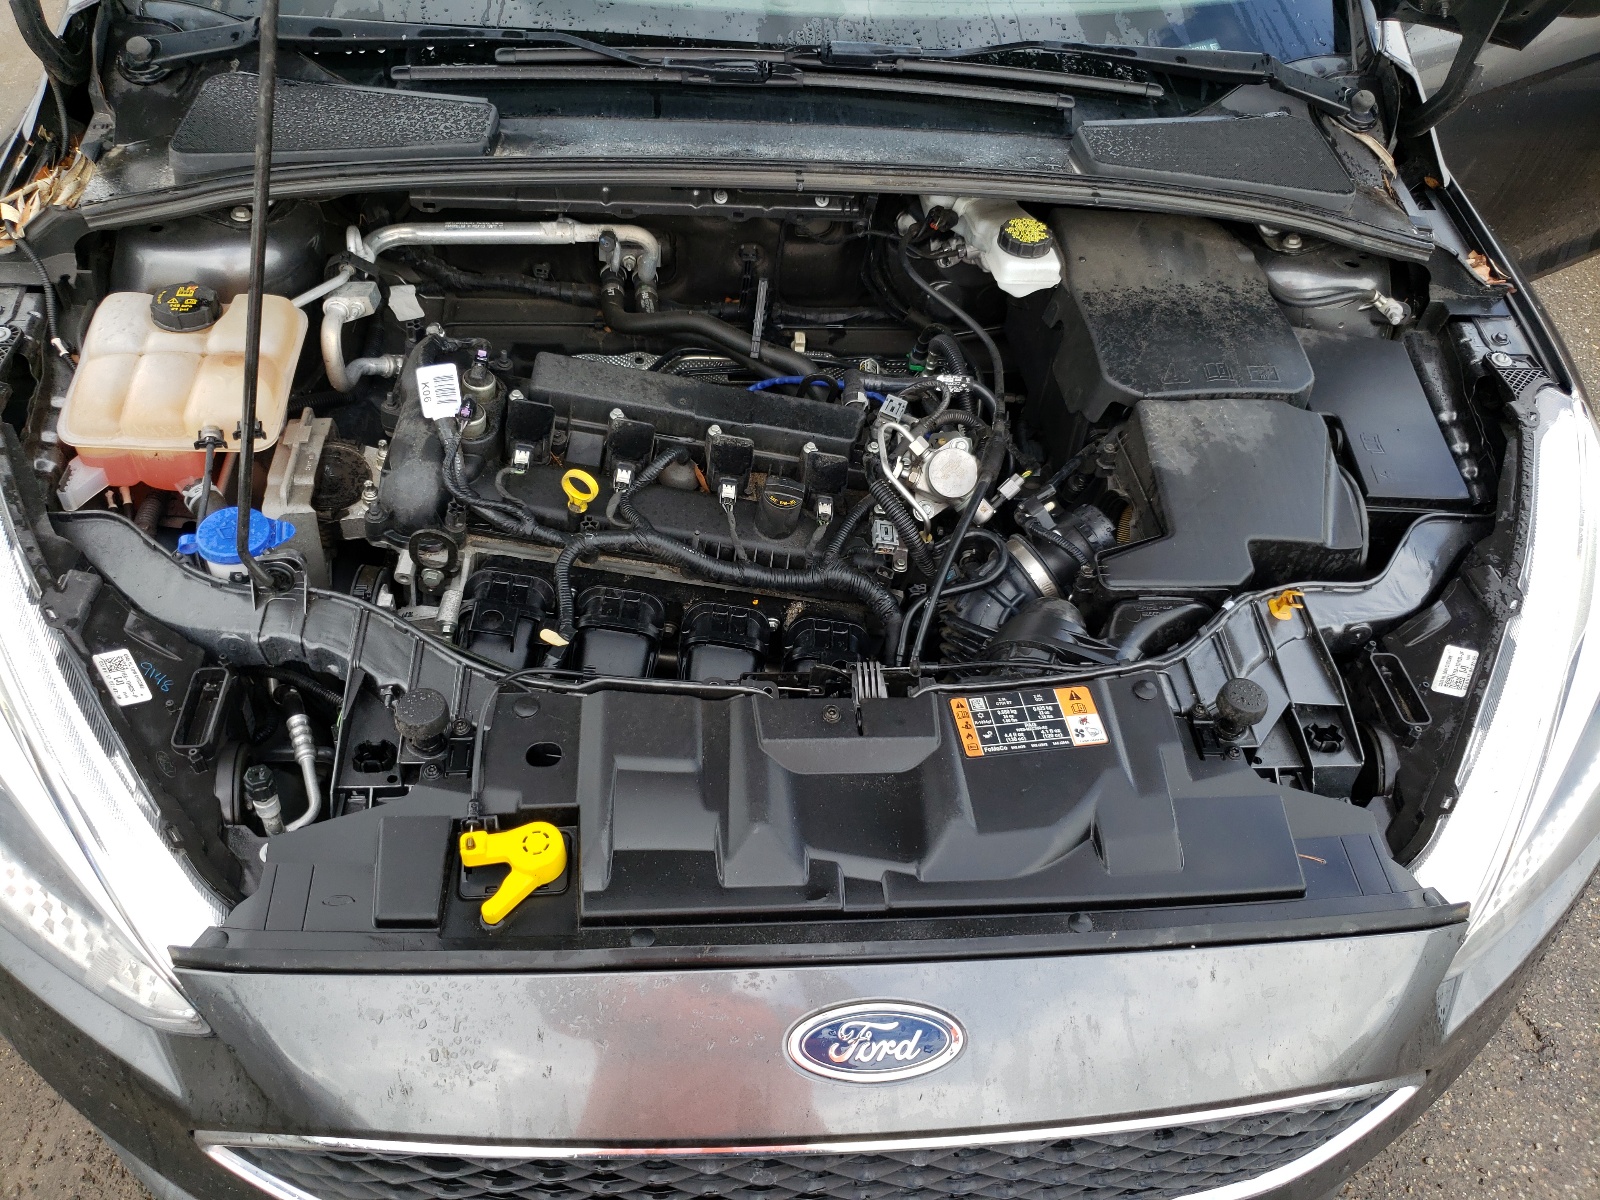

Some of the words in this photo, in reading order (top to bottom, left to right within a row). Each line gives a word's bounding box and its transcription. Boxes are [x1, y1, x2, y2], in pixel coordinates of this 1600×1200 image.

[421, 382, 431, 402] K06
[140, 661, 175, 692] 9148
[828, 1021, 923, 1063] Ford
